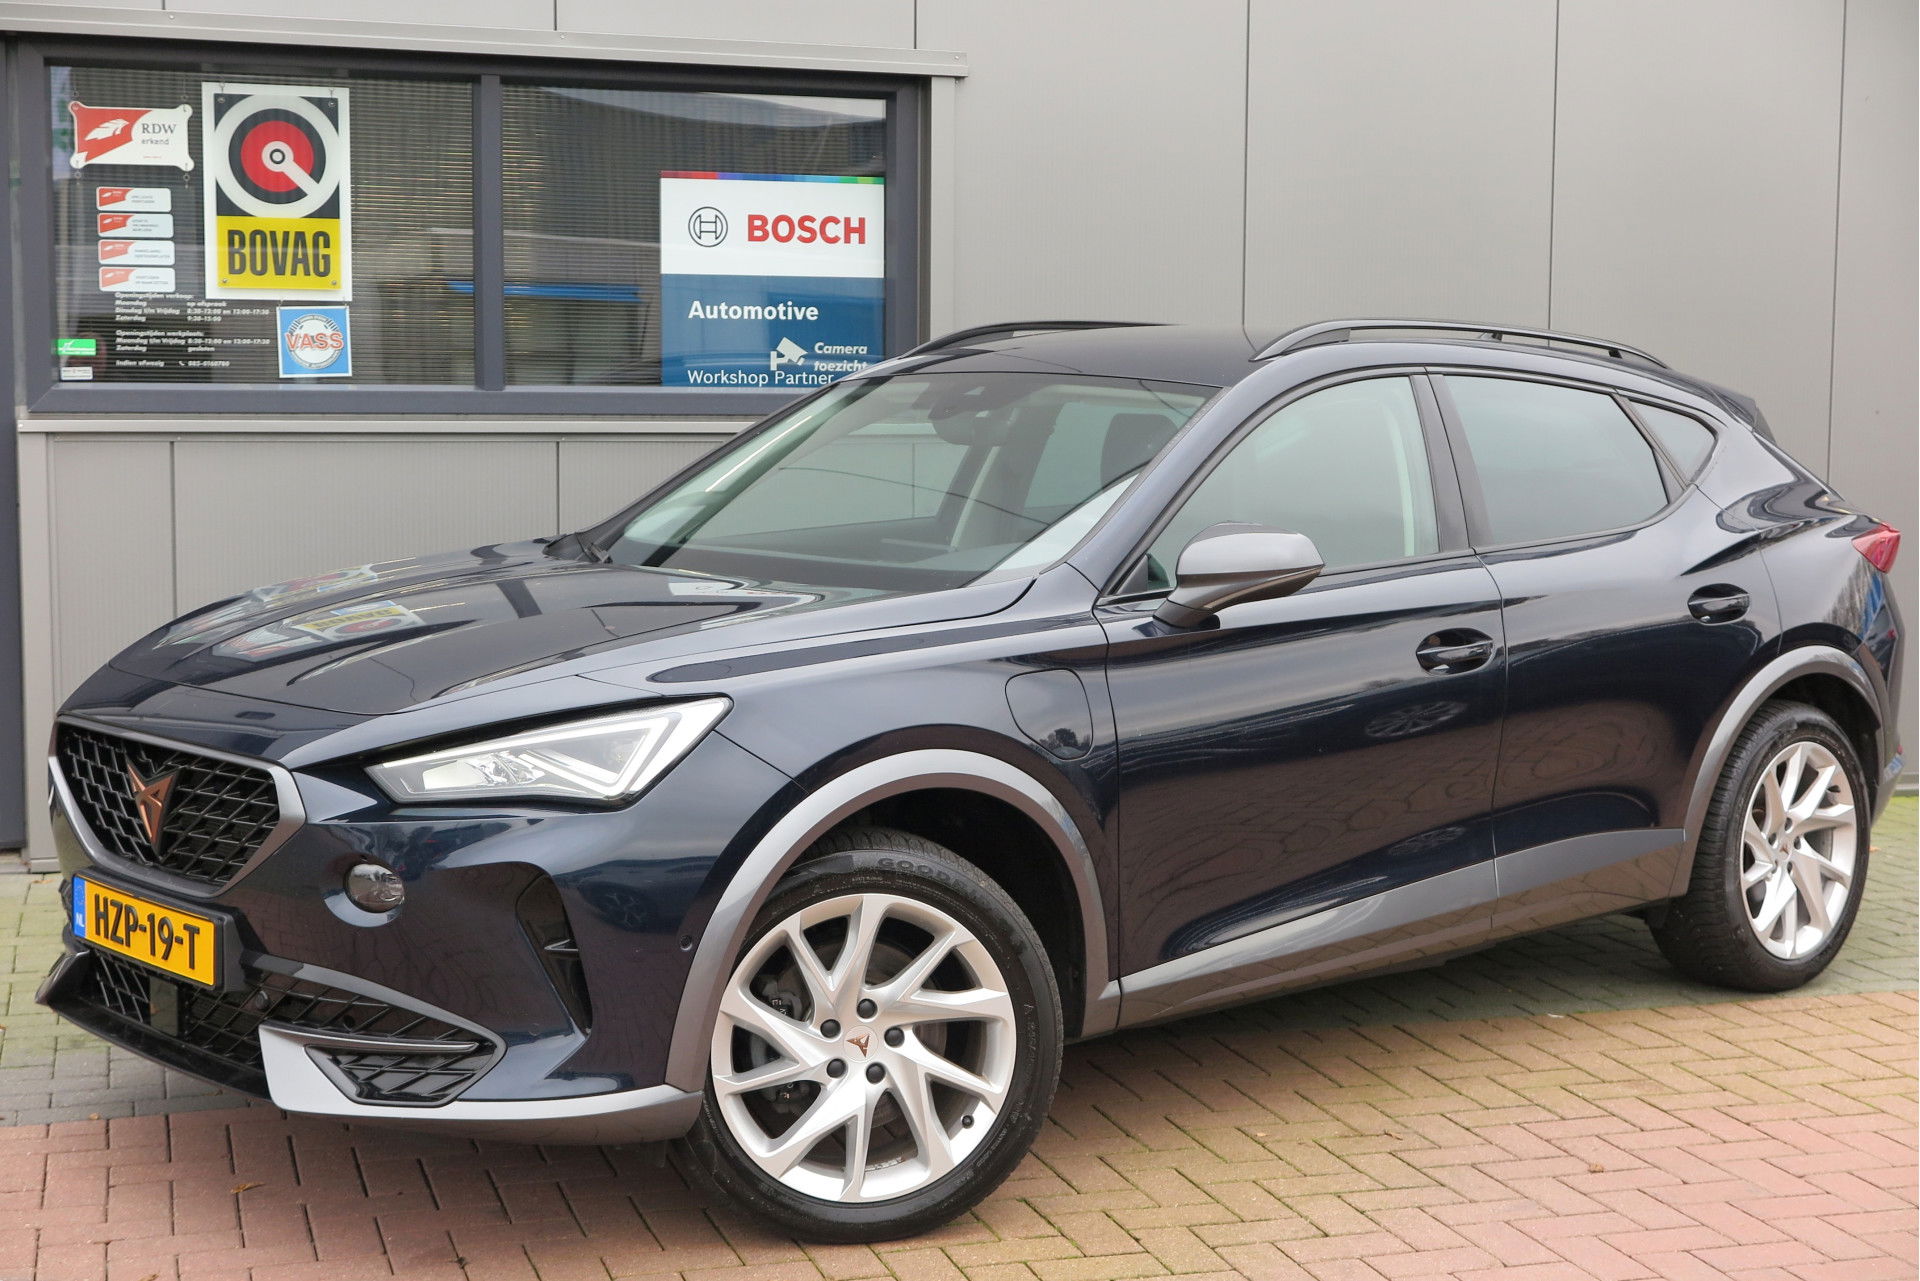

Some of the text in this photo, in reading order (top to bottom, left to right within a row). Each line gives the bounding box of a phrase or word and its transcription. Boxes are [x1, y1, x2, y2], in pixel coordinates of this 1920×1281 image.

[141, 123, 177, 135] RDW
[747, 214, 866, 245] BOSCH
[227, 229, 331, 277] BOVAG
[688, 300, 819, 321] Automotive
[284, 332, 345, 350] VASS
[814, 341, 868, 354] Camera
[814, 360, 868, 372] toezicht
[687, 369, 834, 387] Workshop Partner
[76, 911, 85, 927] NL
[94, 893, 200, 970] HZP-19-T
